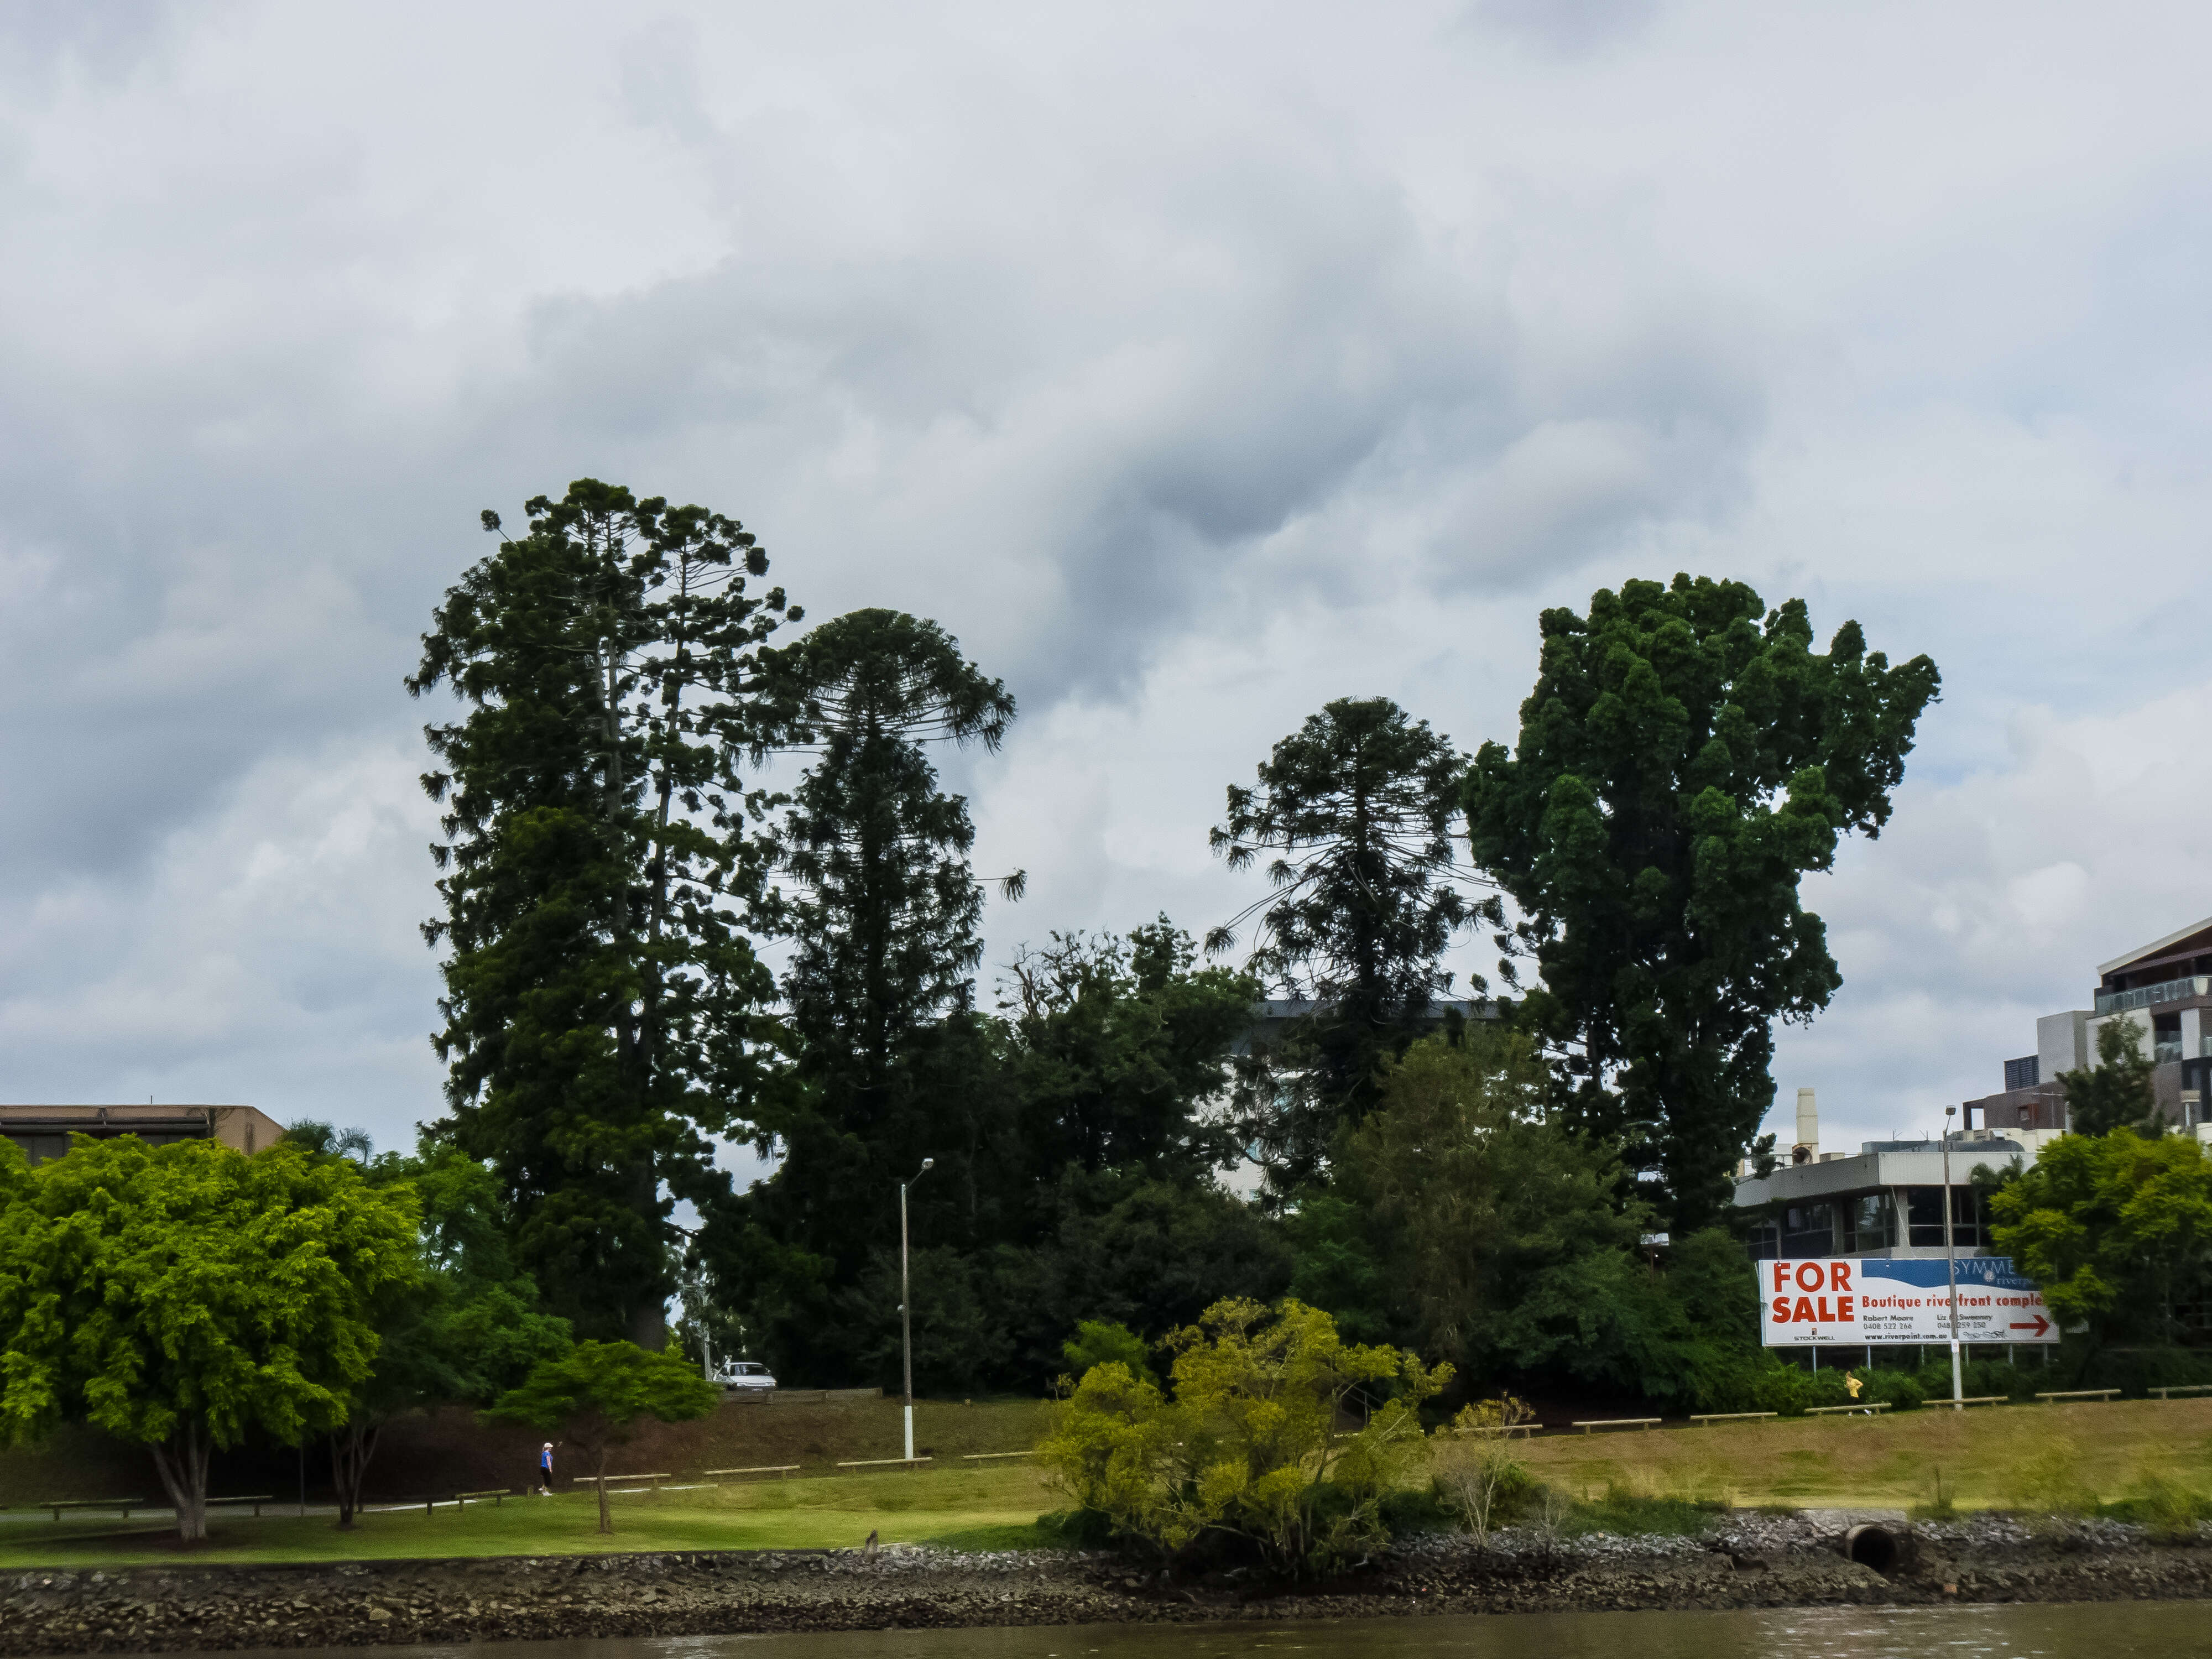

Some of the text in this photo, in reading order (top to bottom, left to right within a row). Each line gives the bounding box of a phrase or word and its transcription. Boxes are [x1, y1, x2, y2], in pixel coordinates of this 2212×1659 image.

[1773, 1261, 1853, 1292] FOR
[1954, 1260, 2016, 1275] SYMME
[1772, 1296, 1855, 1323] SALE
[1862, 1292, 2042, 1310] Boutique rivefront comple
